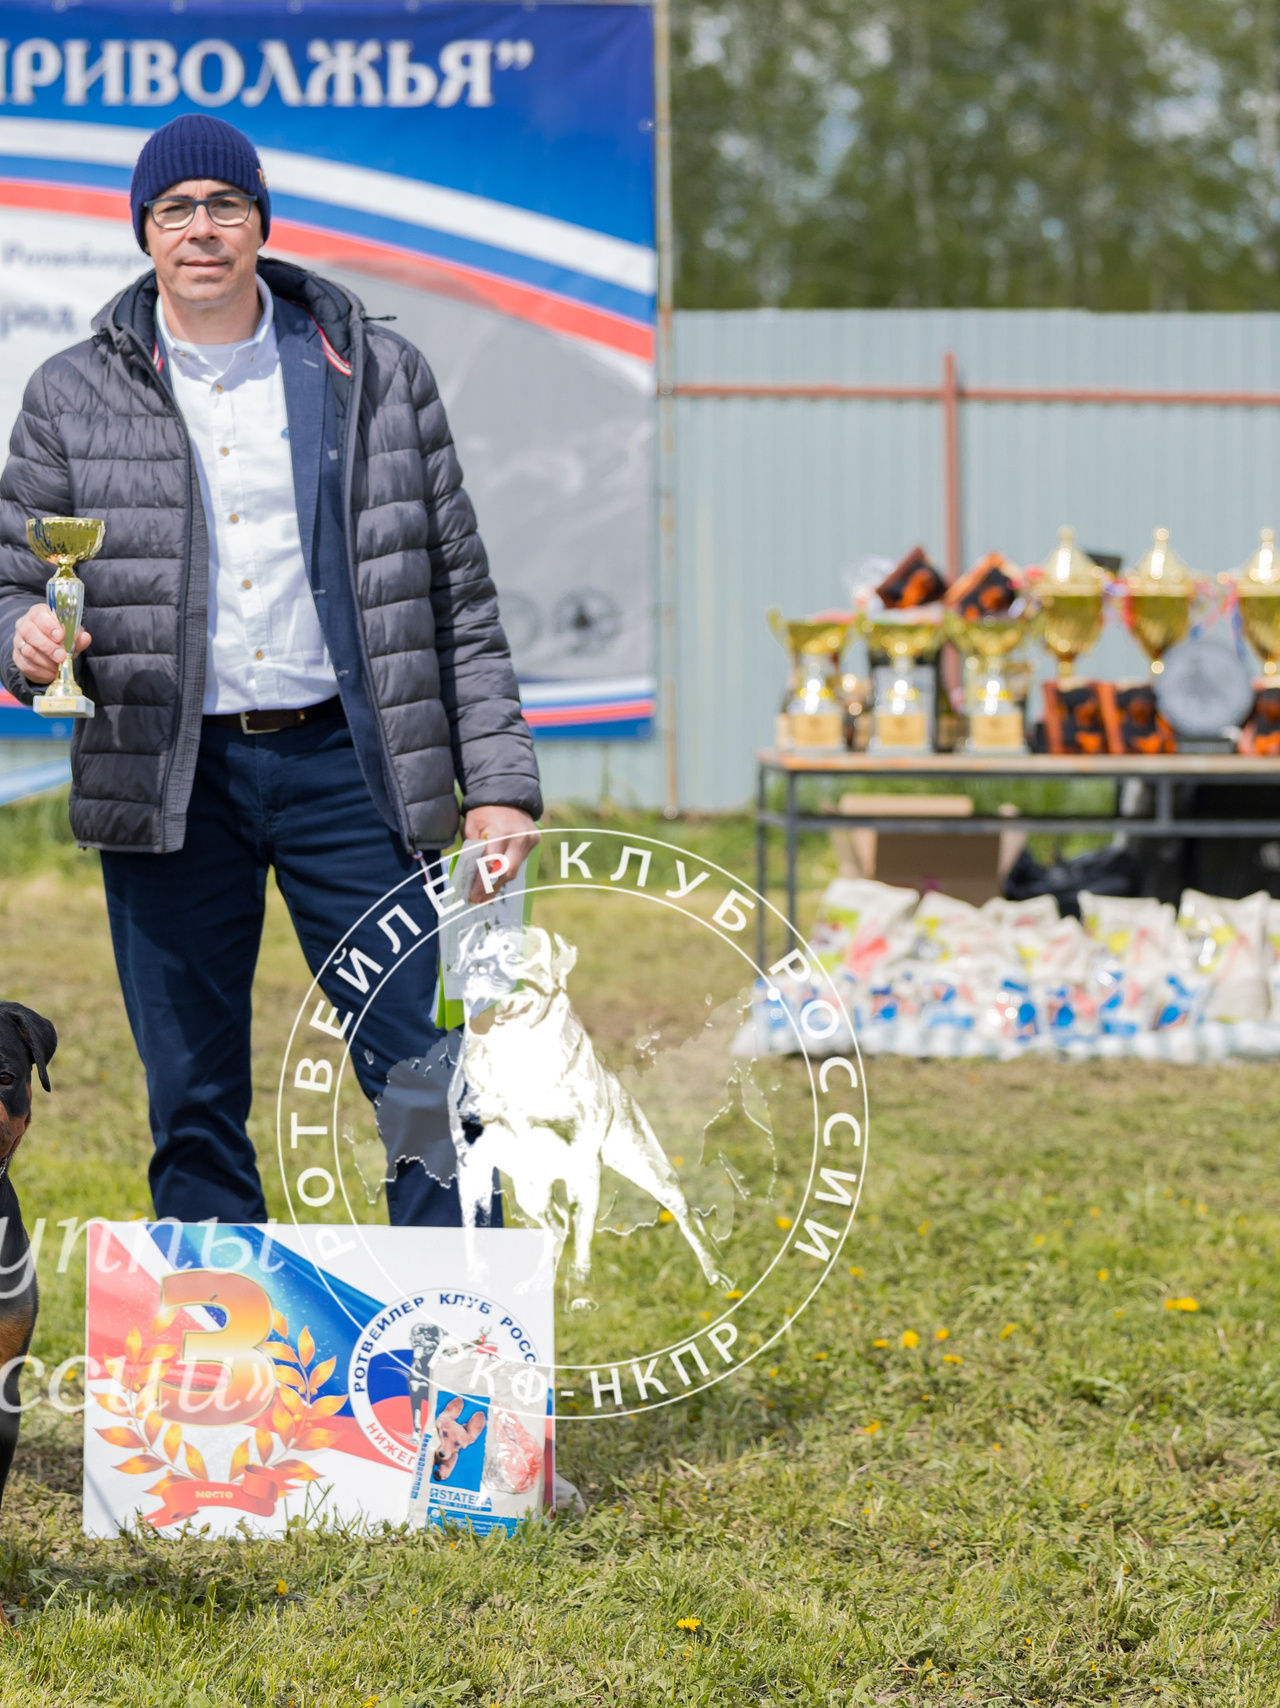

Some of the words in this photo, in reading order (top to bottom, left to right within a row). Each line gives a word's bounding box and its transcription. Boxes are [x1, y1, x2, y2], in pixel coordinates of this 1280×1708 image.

[158, 1268, 277, 1428] 3
[353, 1296, 425, 1393] РОТВЕЙЛЕР
[439, 1293, 493, 1315] КЛУБ
